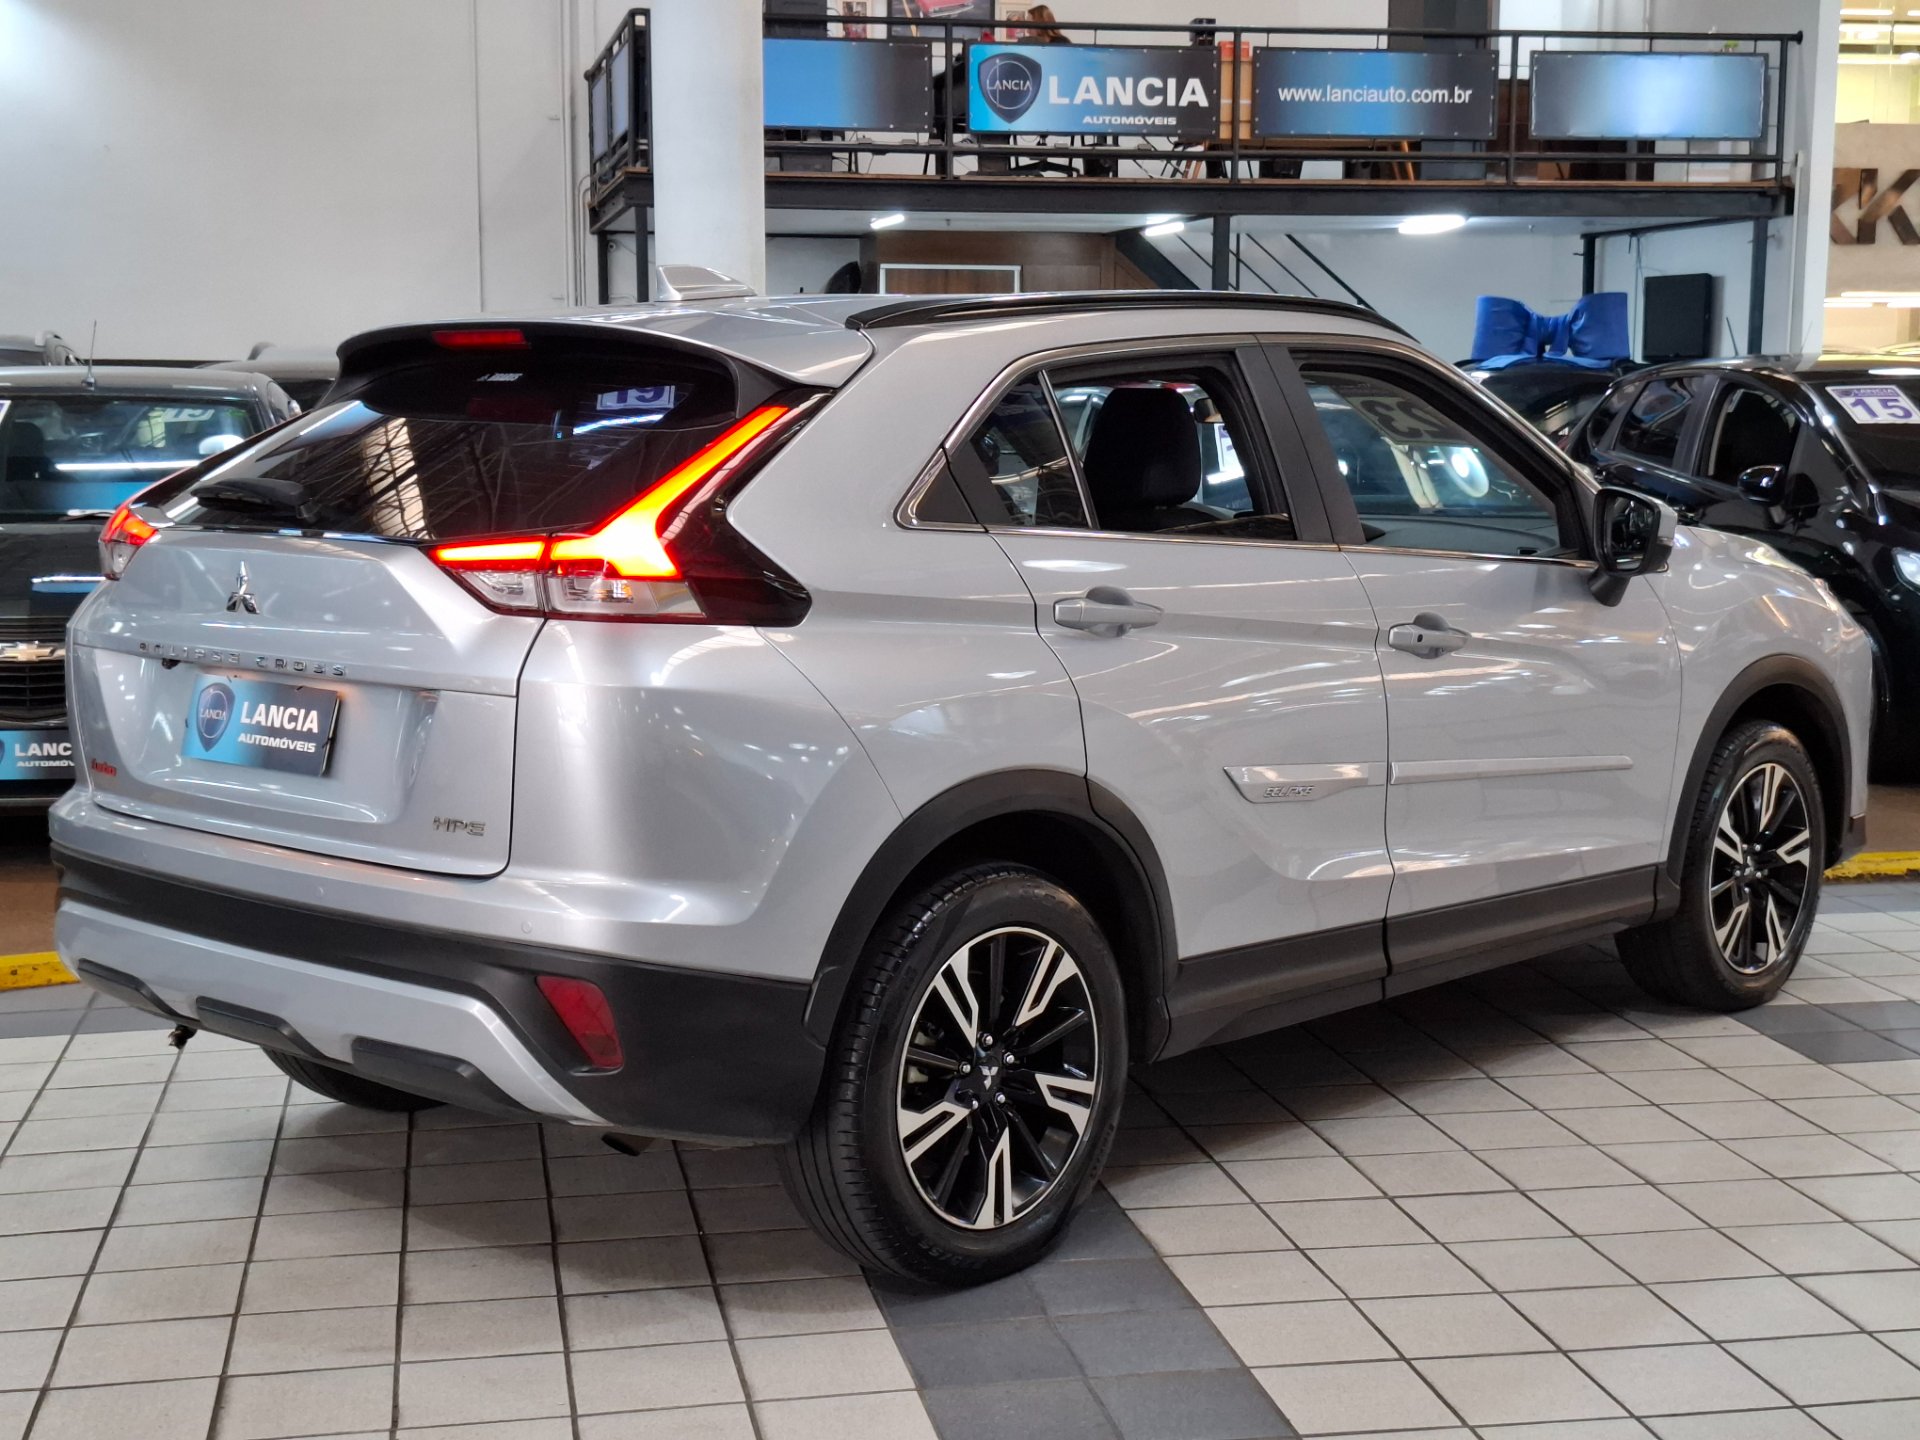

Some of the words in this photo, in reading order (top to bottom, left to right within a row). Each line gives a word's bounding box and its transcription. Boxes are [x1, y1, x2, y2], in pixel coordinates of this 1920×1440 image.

[986, 79, 1032, 91] LANCIA
[1048, 75, 1209, 108] LANCIA
[1278, 84, 1473, 104] www.lanciauto.com.br
[1082, 115, 1177, 126] AUTOMÓVEIS
[1850, 398, 1913, 420] 15
[256, 656, 347, 677] CROSS
[199, 708, 227, 721] LANCIA
[239, 701, 319, 734] LANCIA
[14, 742, 73, 757] LANC
[238, 732, 316, 753] AUTOMÓVEIS
